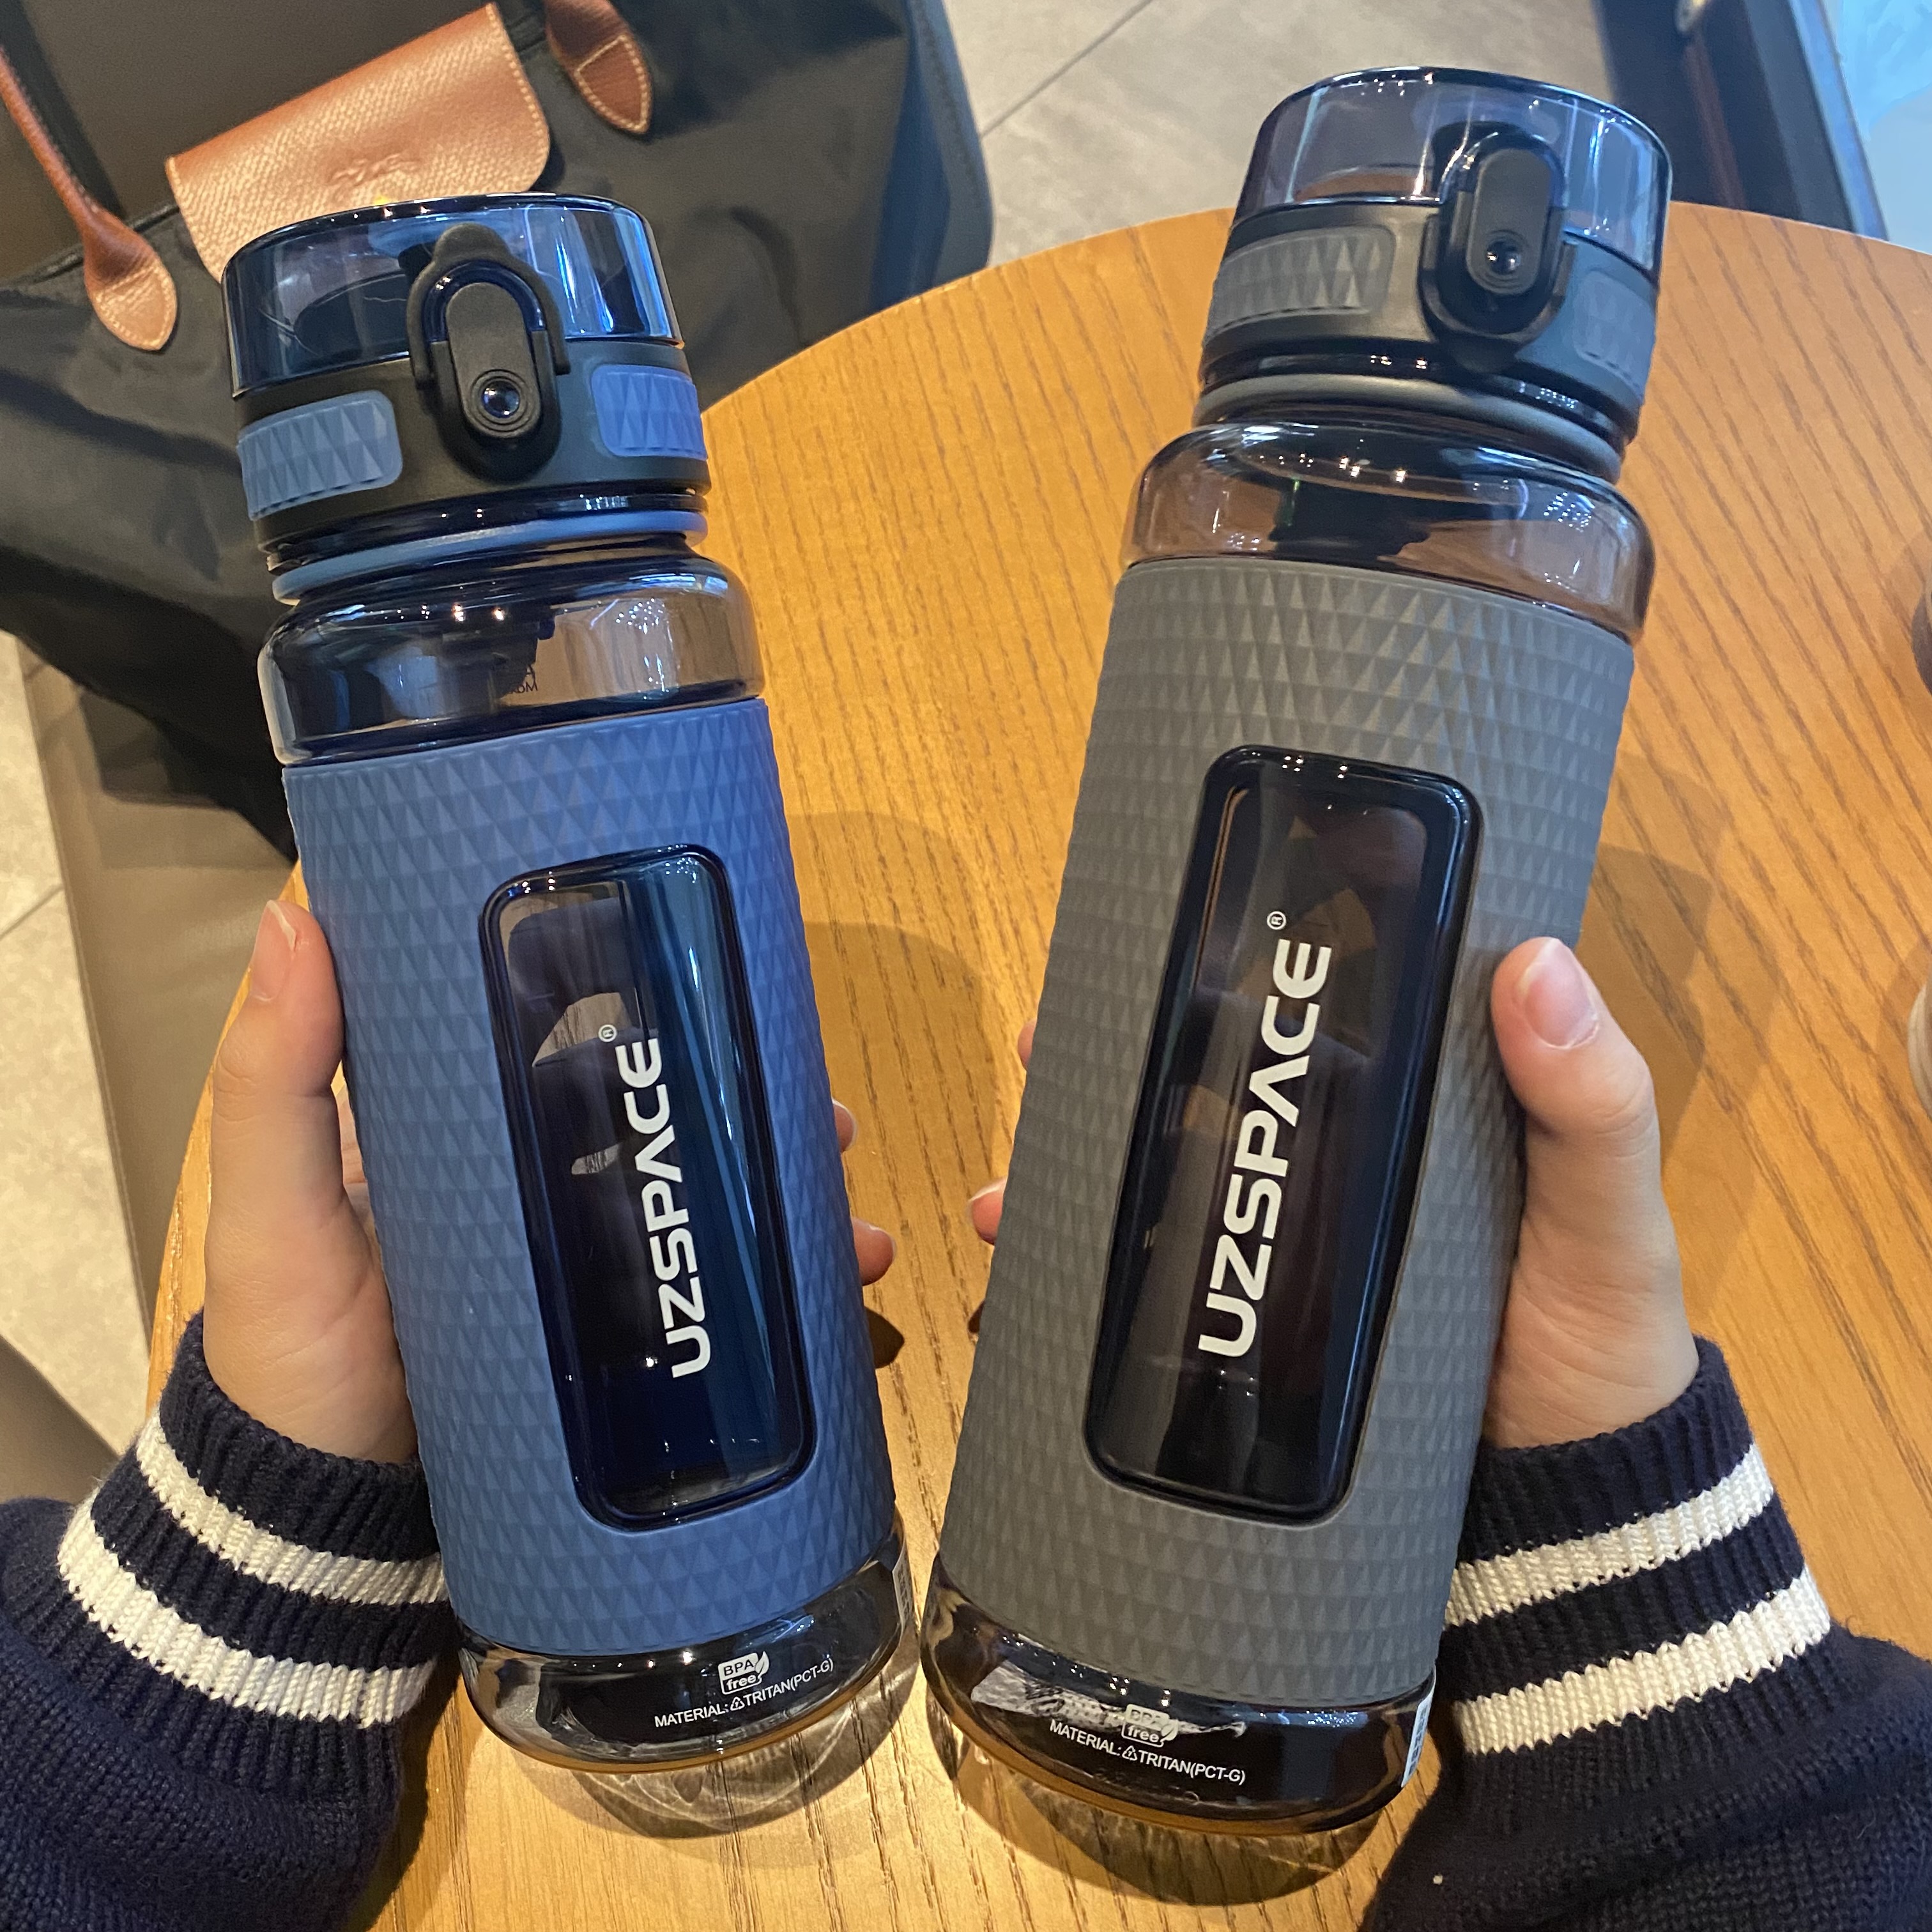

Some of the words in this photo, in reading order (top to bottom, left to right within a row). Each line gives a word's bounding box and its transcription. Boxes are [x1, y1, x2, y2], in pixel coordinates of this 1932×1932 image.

[1198, 939, 1332, 1358] UZSPACE
[615, 1038, 711, 1378] UZSPACE
[654, 1703, 729, 1728] MATERIAL:
[742, 1658, 834, 1706] TRITAN(PCT-G)
[723, 1659, 755, 1676] BPA
[726, 1675, 756, 1690] free
[1050, 1719, 1121, 1756] MATERIAL:
[1138, 1749, 1246, 1786] TRITAN(PCT-G)
[1128, 1724, 1160, 1743] free
